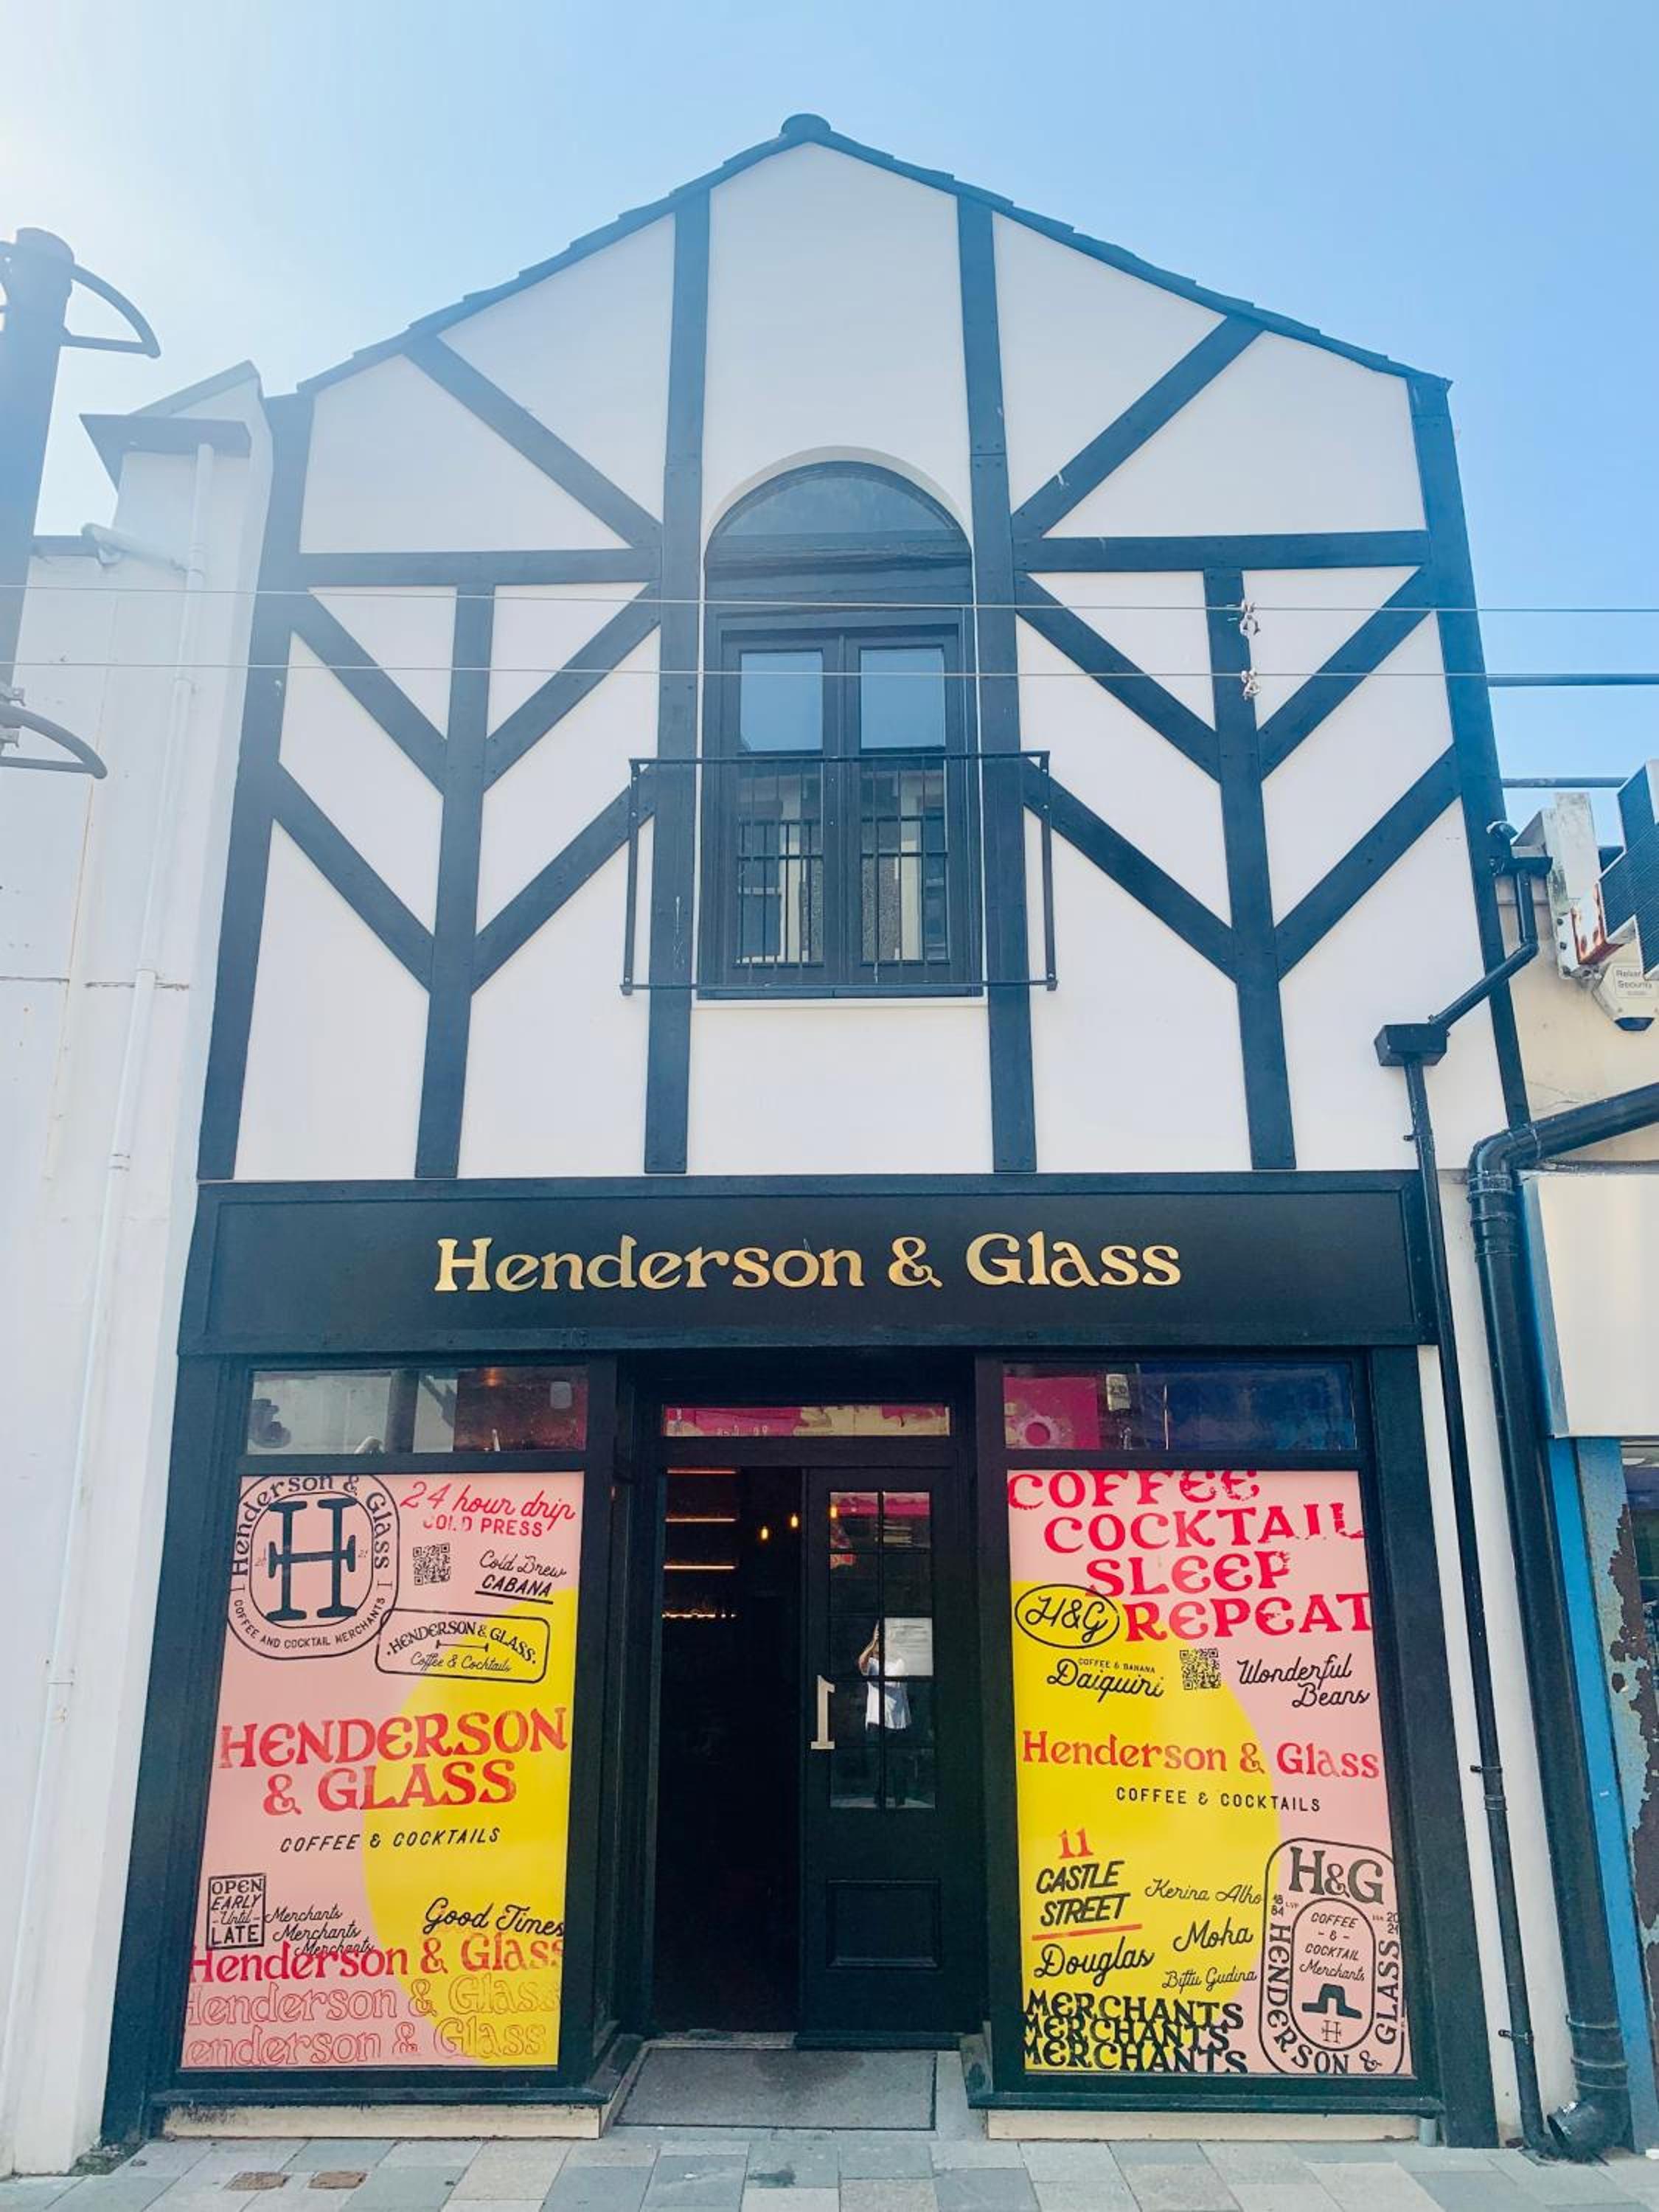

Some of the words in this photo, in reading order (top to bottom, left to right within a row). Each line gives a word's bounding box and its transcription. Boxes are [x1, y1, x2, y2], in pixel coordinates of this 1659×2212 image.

[434, 1235, 864, 1292] Henderson
[888, 1237, 943, 1289] &
[967, 1231, 1181, 1289] Glass
[400, 1481, 451, 1509] 24
[453, 1484, 516, 1516] hour
[521, 1490, 577, 1531] drip
[1007, 1470, 1258, 1510] COFFEE
[232, 1475, 333, 1576] Henderson
[343, 1475, 360, 1496] &
[366, 1491, 394, 1571] Glass
[480, 1517, 543, 1537] PRESS
[1044, 1502, 1367, 1553] COCKTAIL
[479, 1548, 514, 1573] Cold
[517, 1554, 567, 1578] Brew
[1085, 1550, 1291, 1597] SLEEP
[481, 1574, 552, 1598] CABANA
[234, 1599, 261, 1639] COFFEE
[260, 1635, 282, 1649] AND
[284, 1636, 331, 1649] COCKTAIL
[335, 1597, 386, 1644] MERCHANTS
[1026, 1596, 1109, 1643] H&G
[1122, 1593, 1372, 1642] REPEAT
[389, 1621, 478, 1654] HENDERSON
[477, 1624, 487, 1638] &
[411, 1652, 443, 1672] Coffee
[447, 1655, 457, 1668] &
[1046, 1658, 1165, 1703] Daiquiri
[1079, 1658, 1111, 1669] COFFEE
[1123, 1663, 1156, 1674] BANANA
[1237, 1653, 1353, 1690] Wonderful
[1292, 1682, 1371, 1708] Beans
[220, 1707, 568, 1769] HENDERSON
[1022, 1730, 1227, 1771] Henderson
[1239, 1742, 1265, 1775] &
[1276, 1742, 1380, 1779] Glass
[262, 1773, 302, 1816] &
[317, 1759, 518, 1813] GLASS
[1116, 1787, 1187, 1805] COFFEE
[1199, 1792, 1208, 1806] &
[1220, 1793, 1321, 1812] COCKTAILS
[279, 1833, 361, 1854] COFFEE
[369, 1833, 381, 1848] &
[393, 1826, 501, 1848] COCKTAILS
[1059, 1828, 1094, 1859] 11
[212, 1878, 262, 1896] OPEN
[1036, 1860, 1126, 1893] CASTLE
[1289, 1846, 1384, 1905] H&G
[210, 1894, 262, 1911] EARLY
[264, 1903, 344, 1924] Merchants
[422, 1897, 494, 1935] Good
[495, 1904, 564, 1937] Times
[1040, 1892, 1131, 1927] STREET
[1310, 1911, 1360, 1929] COFFEE
[211, 1924, 259, 1945] LATE
[273, 1919, 362, 1942] Merchants
[295, 1936, 375, 1956] Merchants
[189, 1940, 408, 1983] Henderson
[420, 1937, 448, 1974] &
[1033, 1935, 1156, 1987] Douglas
[1299, 1958, 1365, 1982] Merchants
[1304, 1942, 1360, 1961] COCKTAIL
[187, 1981, 397, 2026] Henderson
[408, 1978, 437, 2018] &
[1025, 1987, 1245, 2030] MERCHANTS
[1267, 1922, 1349, 2074] HENDERSON
[1359, 2050, 1382, 2073] &
[1374, 1940, 1400, 2045] GLASS
[392, 2021, 418, 2055] &
[433, 2016, 547, 2059] Glass
[1023, 2012, 1231, 2056] MERCHANTS
[1023, 2035, 1249, 2073] MERCHANTS
